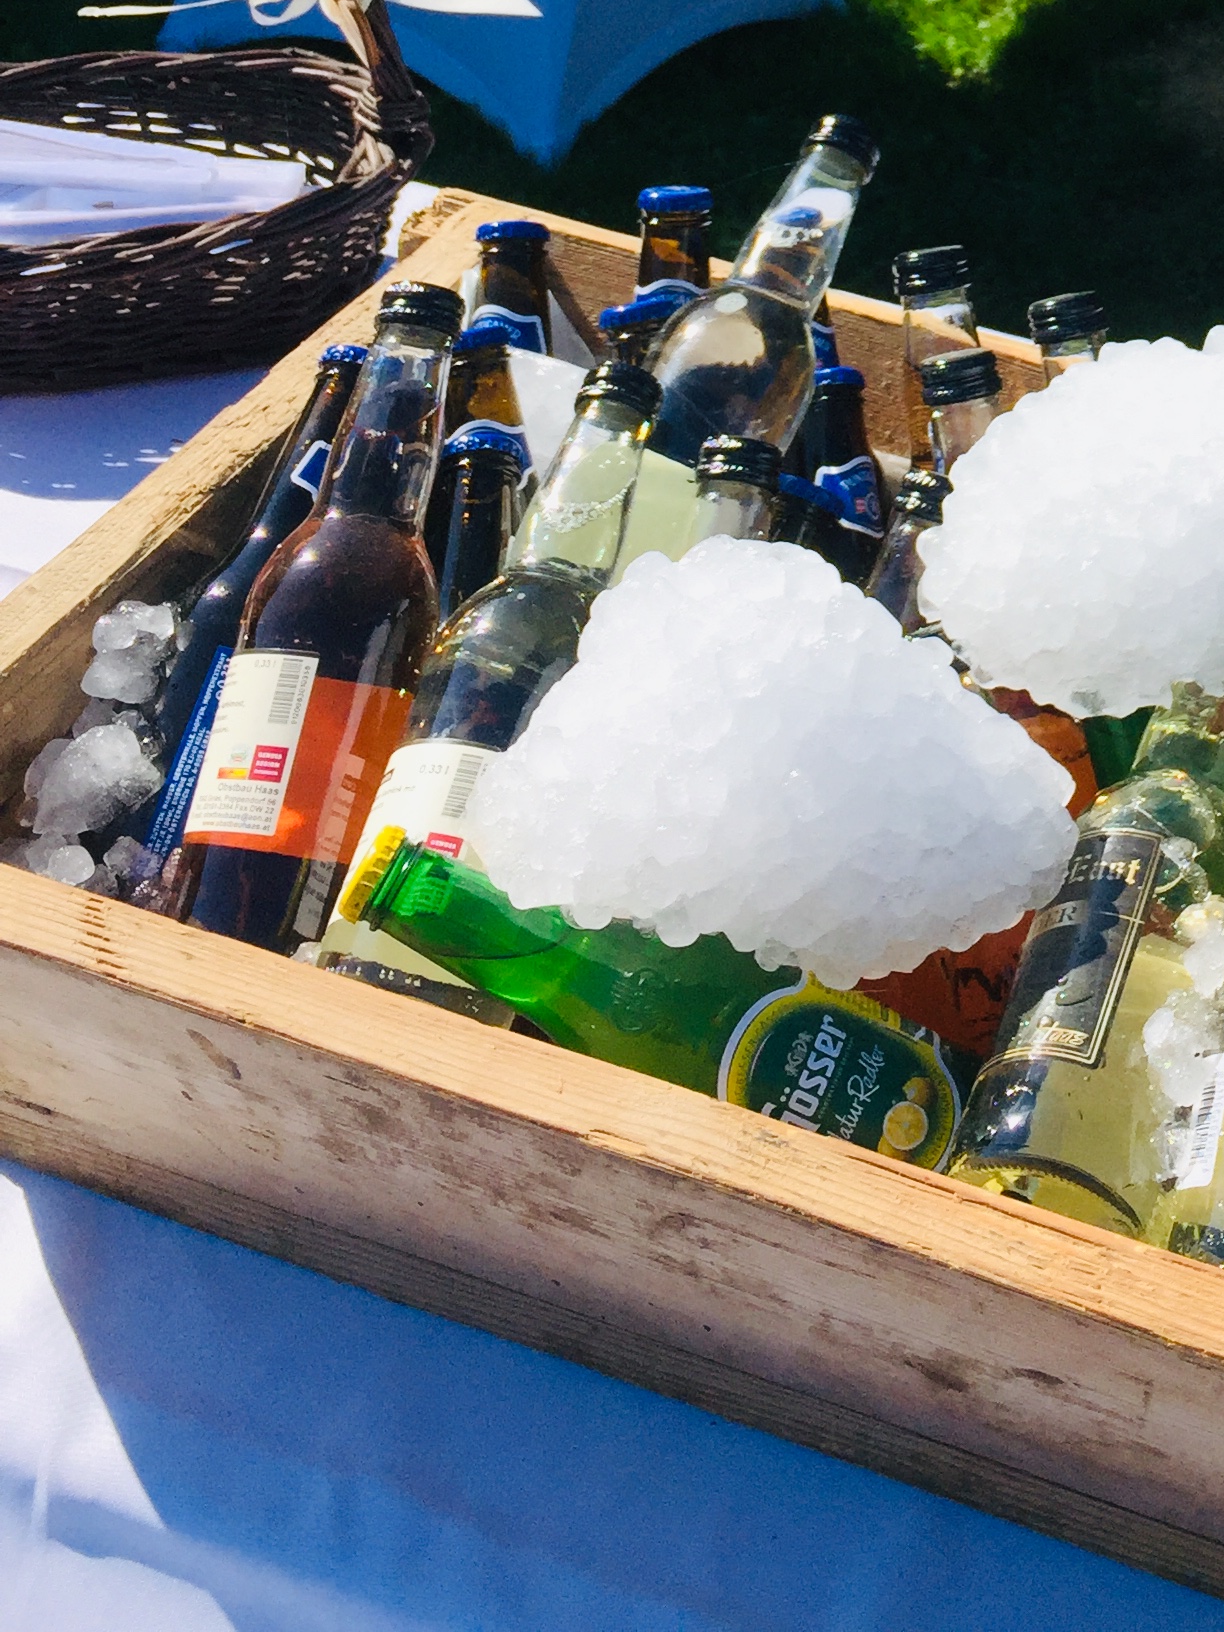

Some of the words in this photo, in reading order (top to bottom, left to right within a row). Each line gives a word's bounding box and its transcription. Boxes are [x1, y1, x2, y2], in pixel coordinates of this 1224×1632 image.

[218, 783, 252, 794] Obstbau
[255, 785, 279, 796] Haas
[234, 803, 248, 812] Fax
[826, 1043, 886, 1142] aturRadler
